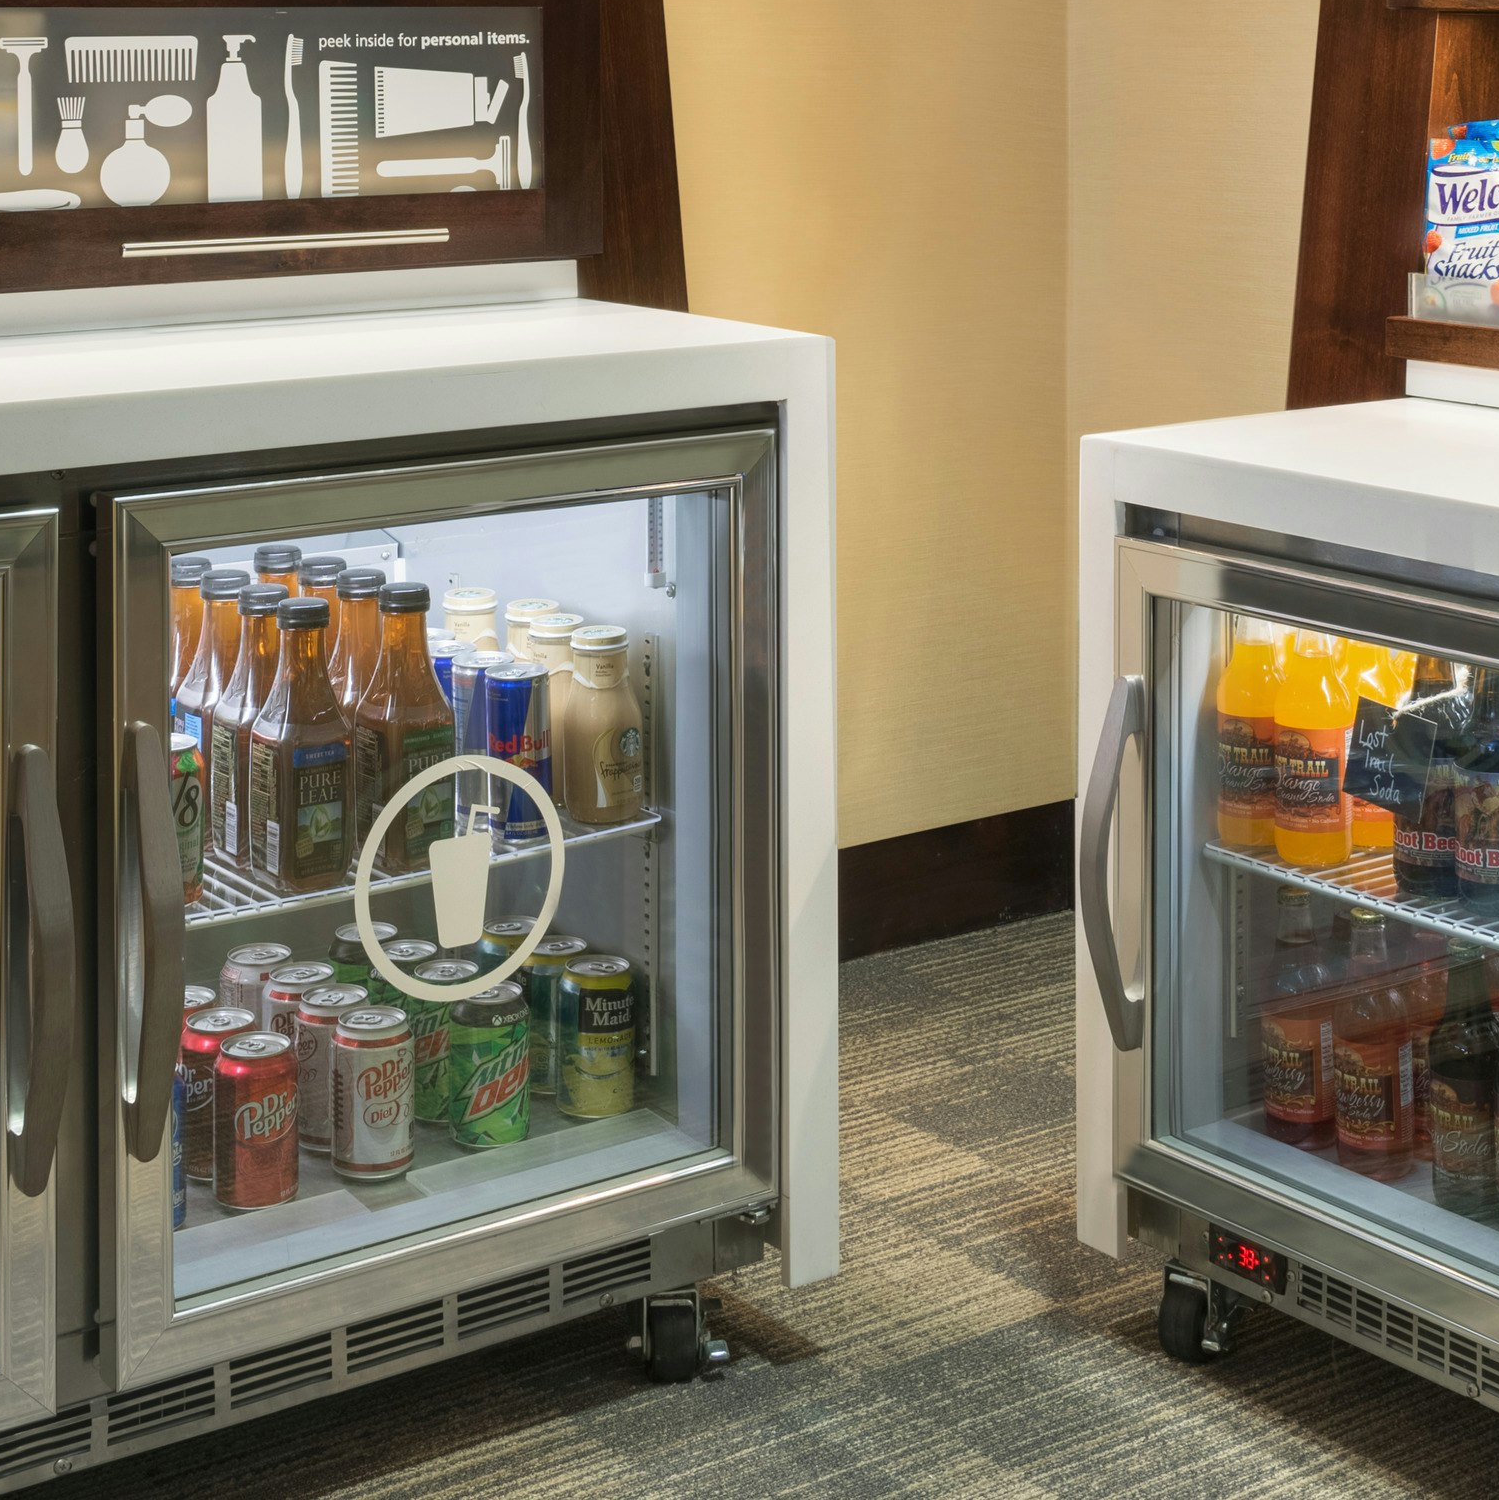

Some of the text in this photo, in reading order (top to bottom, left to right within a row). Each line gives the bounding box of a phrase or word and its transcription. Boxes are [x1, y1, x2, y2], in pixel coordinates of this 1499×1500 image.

[318, 32, 530, 51] peek inside for personal items.
[1459, 223, 1499, 235] MIXED FRUIT
[489, 728, 550, 752] Red Bull
[1359, 721, 1389, 750] Lost
[1290, 761, 1328, 778] TRAIL
[1365, 751, 1393, 777] Trail
[300, 770, 341, 790] PURE
[1370, 775, 1401, 804] Soda
[300, 789, 339, 805] LEAF
[585, 996, 634, 1011] Minute
[592, 1008, 631, 1026] Maid
[241, 1094, 298, 1140] Pepper
[371, 1107, 393, 1123] Diet
[1239, 1246, 1255, 1270] 38
